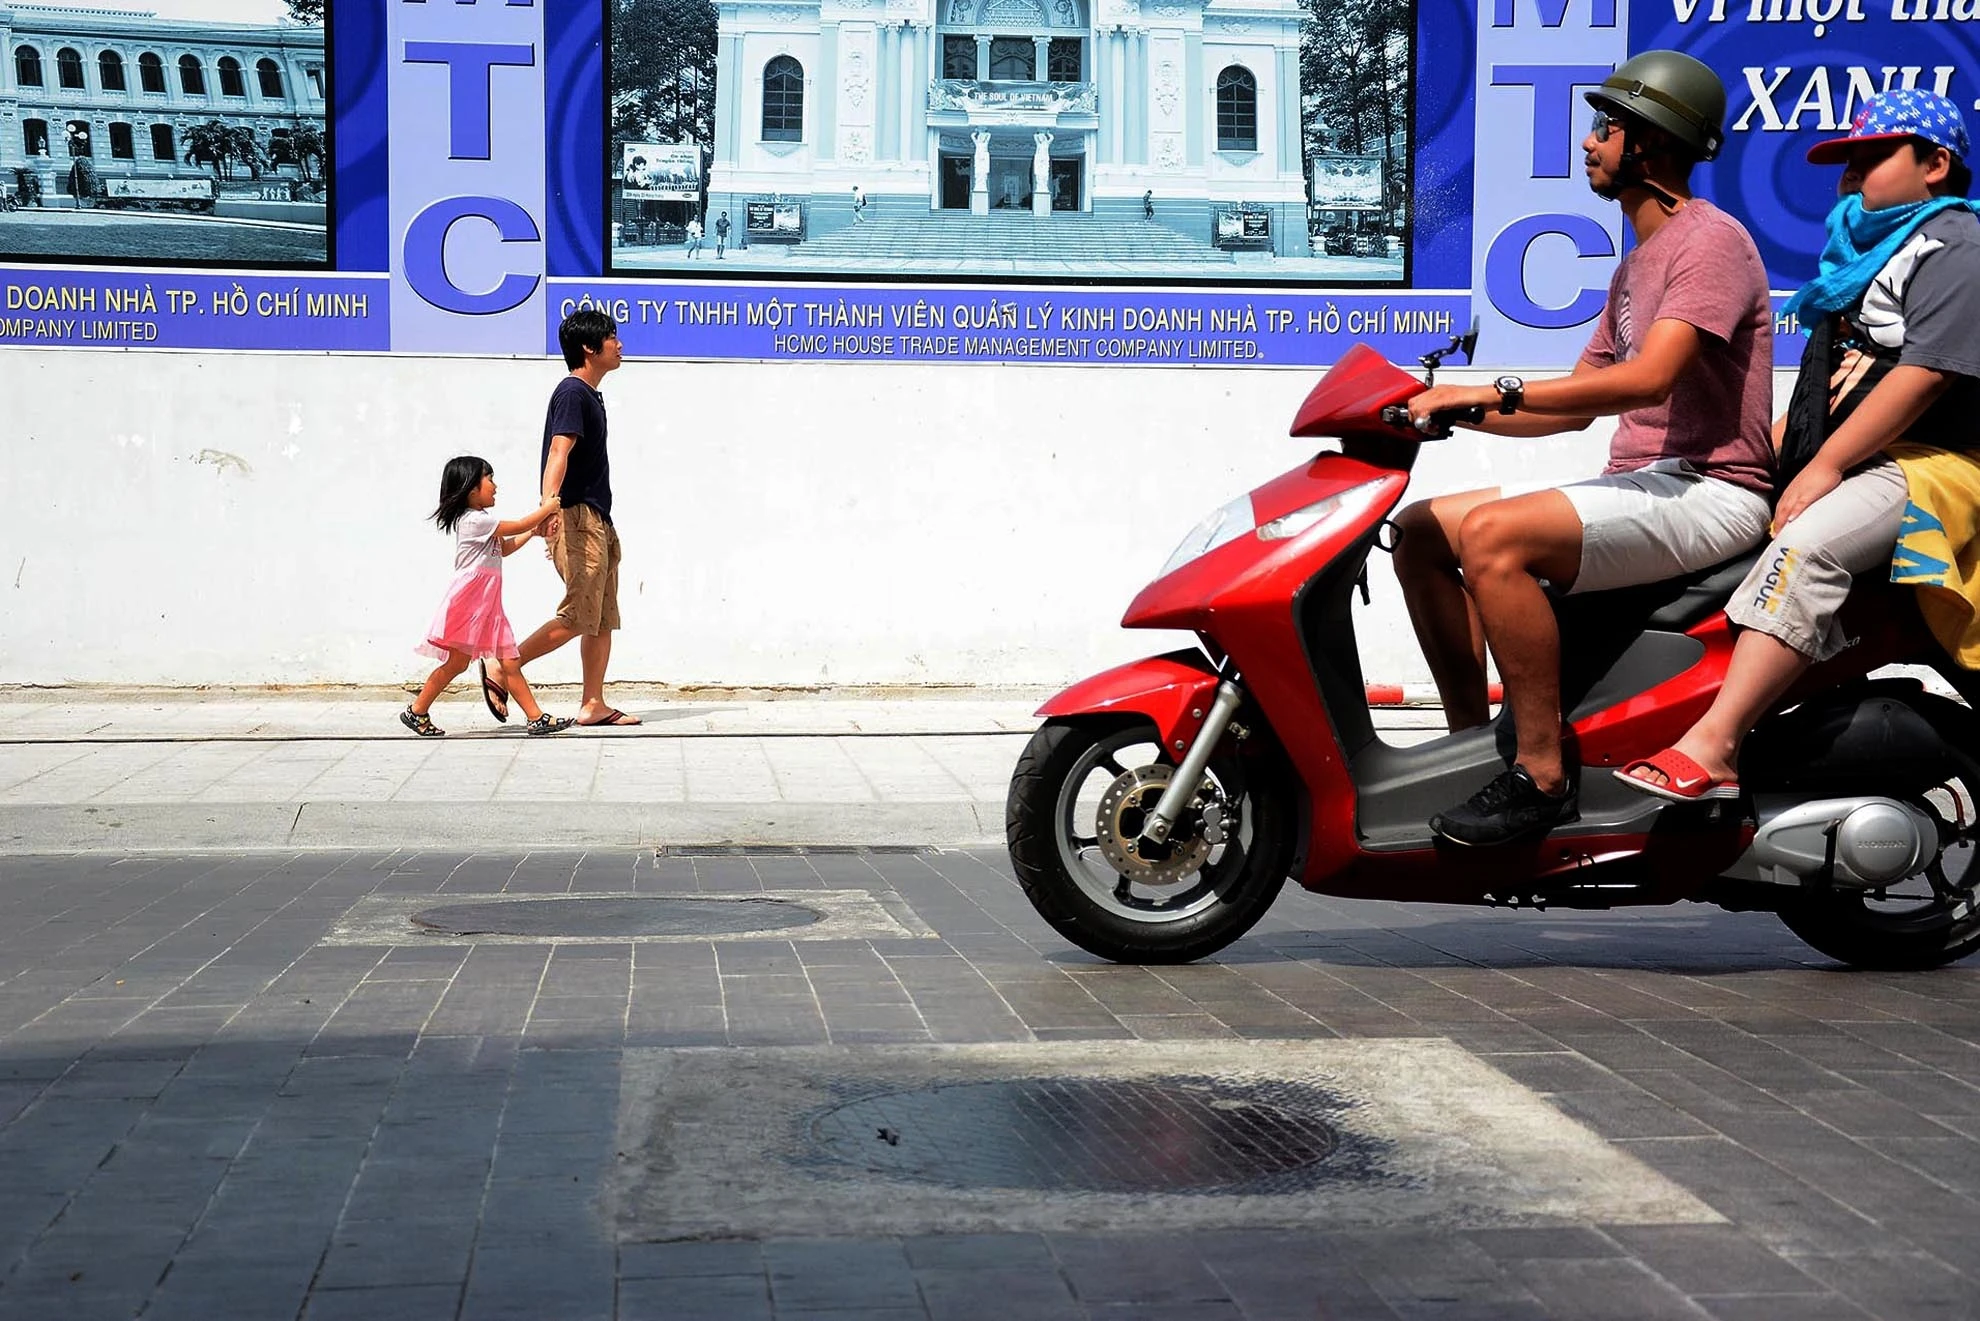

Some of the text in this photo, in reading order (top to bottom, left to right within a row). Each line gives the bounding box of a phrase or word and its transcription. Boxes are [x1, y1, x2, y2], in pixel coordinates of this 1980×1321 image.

[8, 283, 367, 317] DOANH NHÀ TP. HỒ CHÍ MINH
[638, 301, 667, 323] TY
[675, 301, 738, 325] TNHH
[748, 297, 797, 330] MỘT
[804, 299, 882, 327] THÀNH
[892, 300, 944, 328] VIÊN
[951, 298, 1017, 330] QUẢN
[1027, 302, 1053, 329] LÝ
[1062, 308, 1114, 330] KINH
[1124, 308, 1202, 331] DOANH
[1211, 304, 1257, 332] NHÀ
[1266, 310, 1299, 333] TP.
[1309, 302, 1340, 333] HỒ
[1348, 306, 1387, 334] CHÍ
[1394, 311, 1450, 333] MINH
[83, 321, 157, 341] LIMITED
[775, 335, 827, 353] HCMC
[834, 336, 894, 354] HOUSE
[900, 337, 959, 354] TRADE
[965, 337, 1091, 357] MANAGEMENT
[1096, 339, 1183, 357] COMPANY
[1753, 547, 1790, 609] VOGUE
